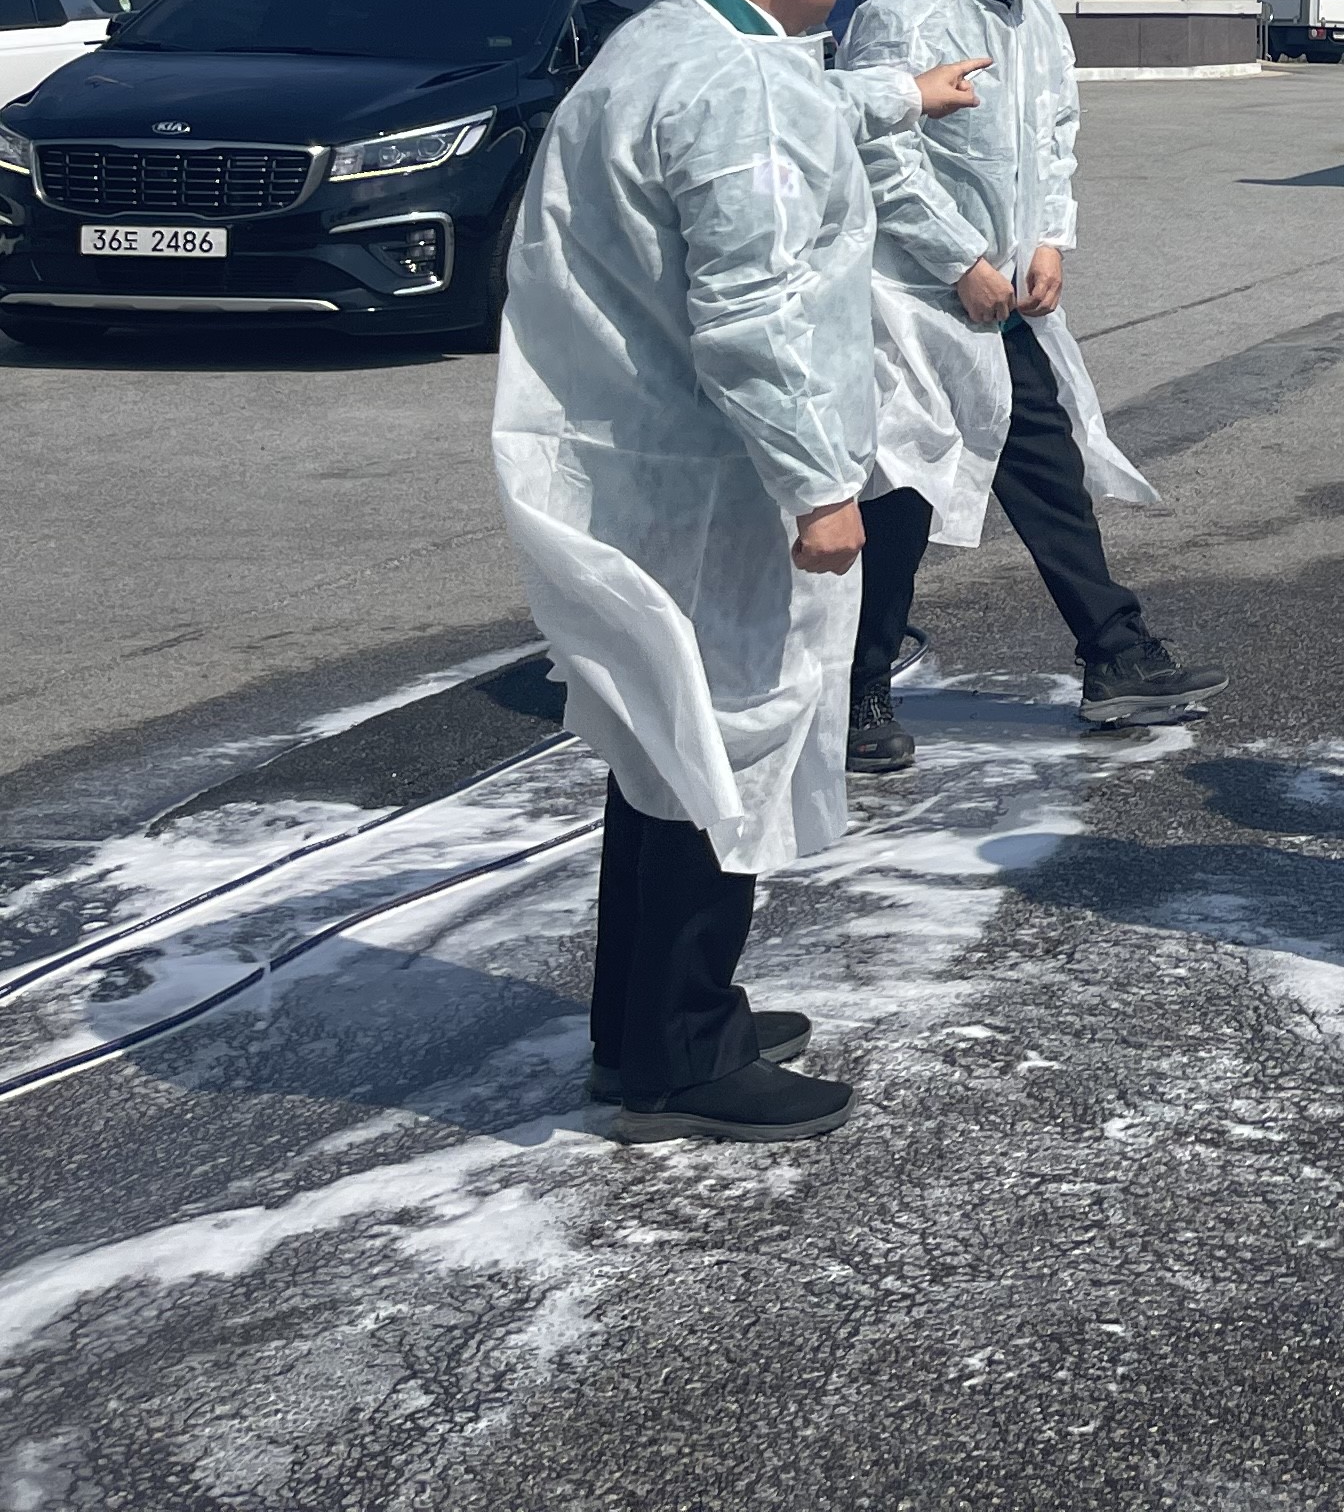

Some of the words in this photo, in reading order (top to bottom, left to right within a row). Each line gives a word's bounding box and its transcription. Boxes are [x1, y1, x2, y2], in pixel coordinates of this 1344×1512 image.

[155, 121, 184, 132] KIA
[93, 228, 138, 251] 36도
[151, 230, 214, 253] 2486
